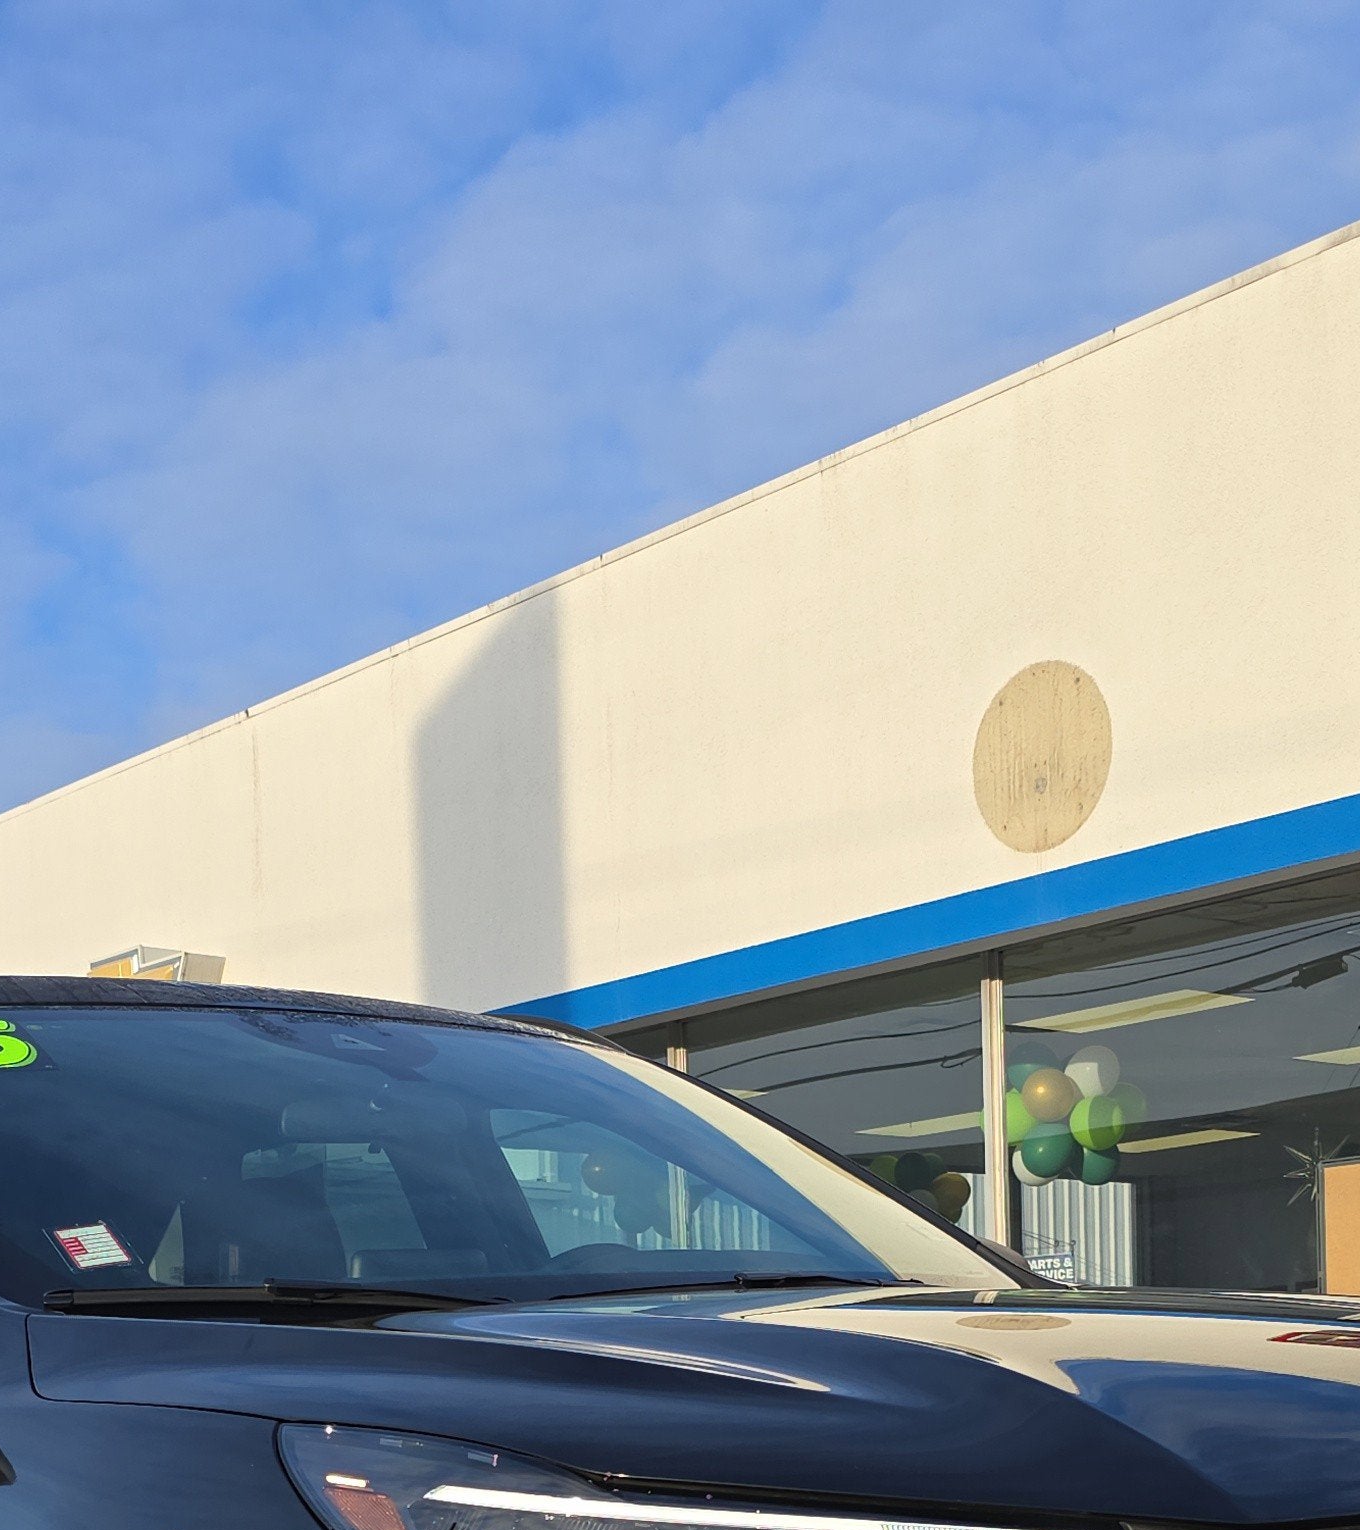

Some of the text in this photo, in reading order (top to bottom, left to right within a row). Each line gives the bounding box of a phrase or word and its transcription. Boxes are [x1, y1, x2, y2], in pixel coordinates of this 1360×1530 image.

[1027, 1257, 1073, 1270] ARTS &
[1035, 1268, 1074, 1280] VICE
